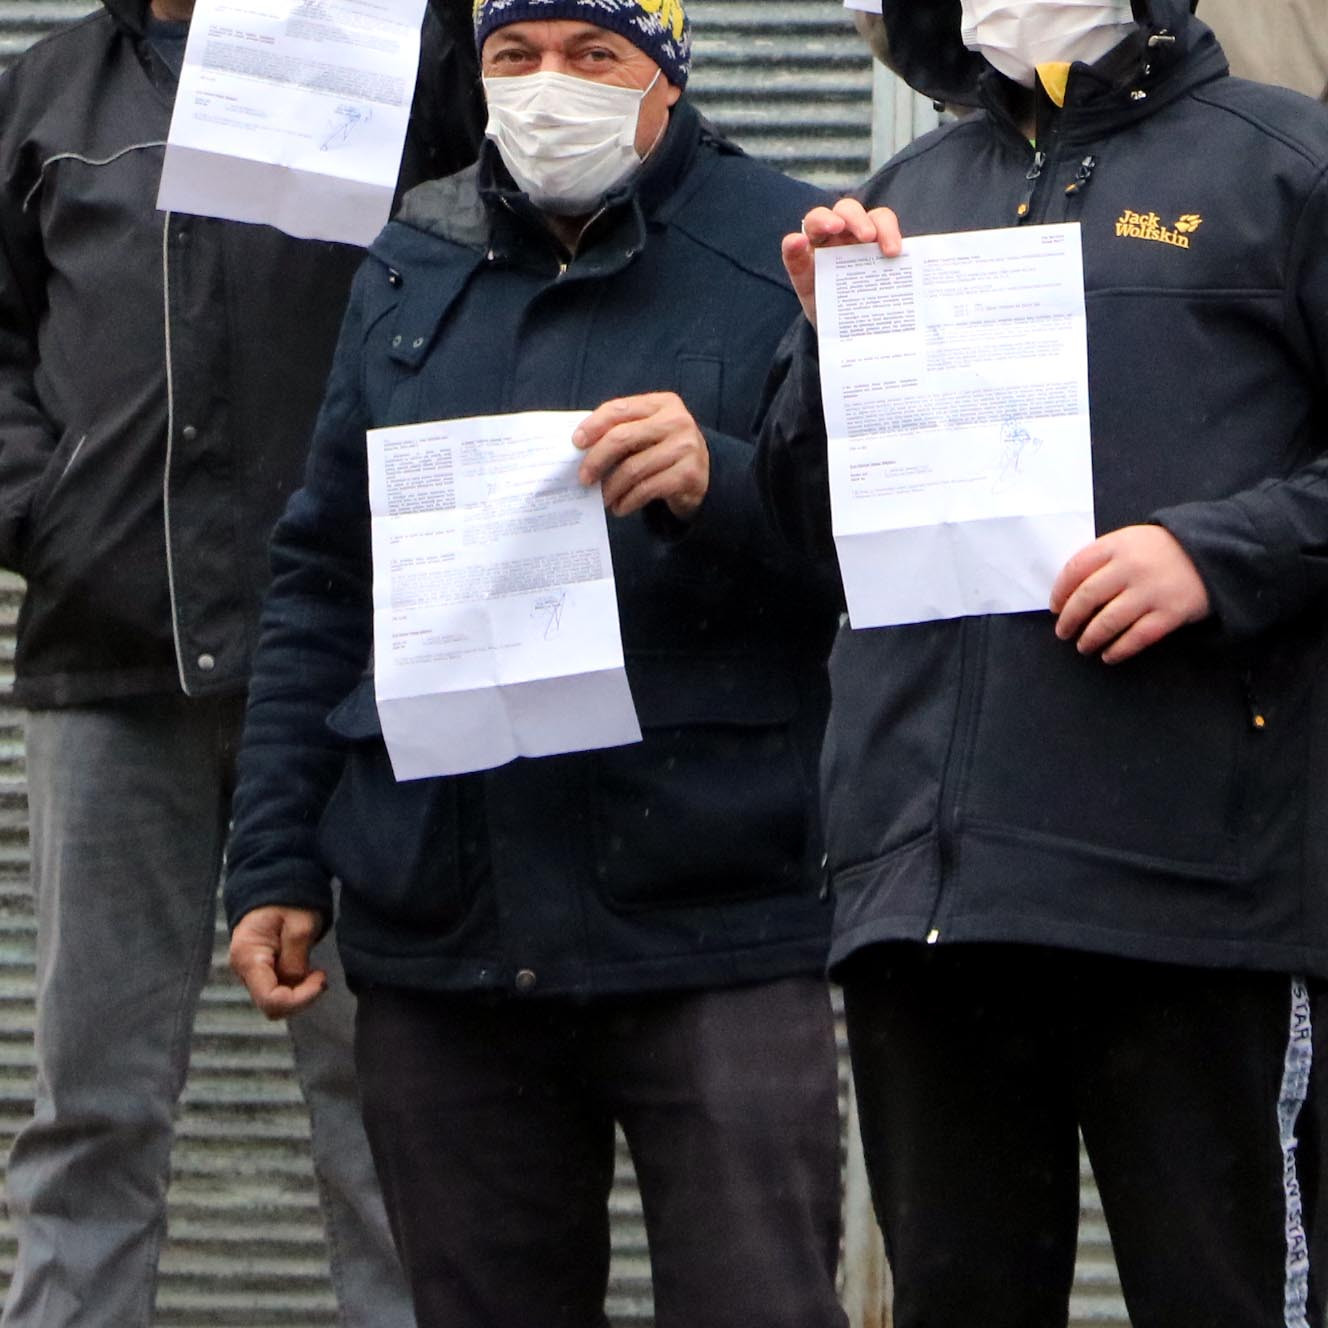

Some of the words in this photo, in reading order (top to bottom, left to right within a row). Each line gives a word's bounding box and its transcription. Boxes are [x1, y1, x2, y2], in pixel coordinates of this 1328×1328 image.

[1116, 223, 1189, 248] Wolfskin
[1119, 210, 1160, 228] Jack
[1291, 984, 1311, 1042] STAR
[1286, 1210, 1308, 1265] STAR
